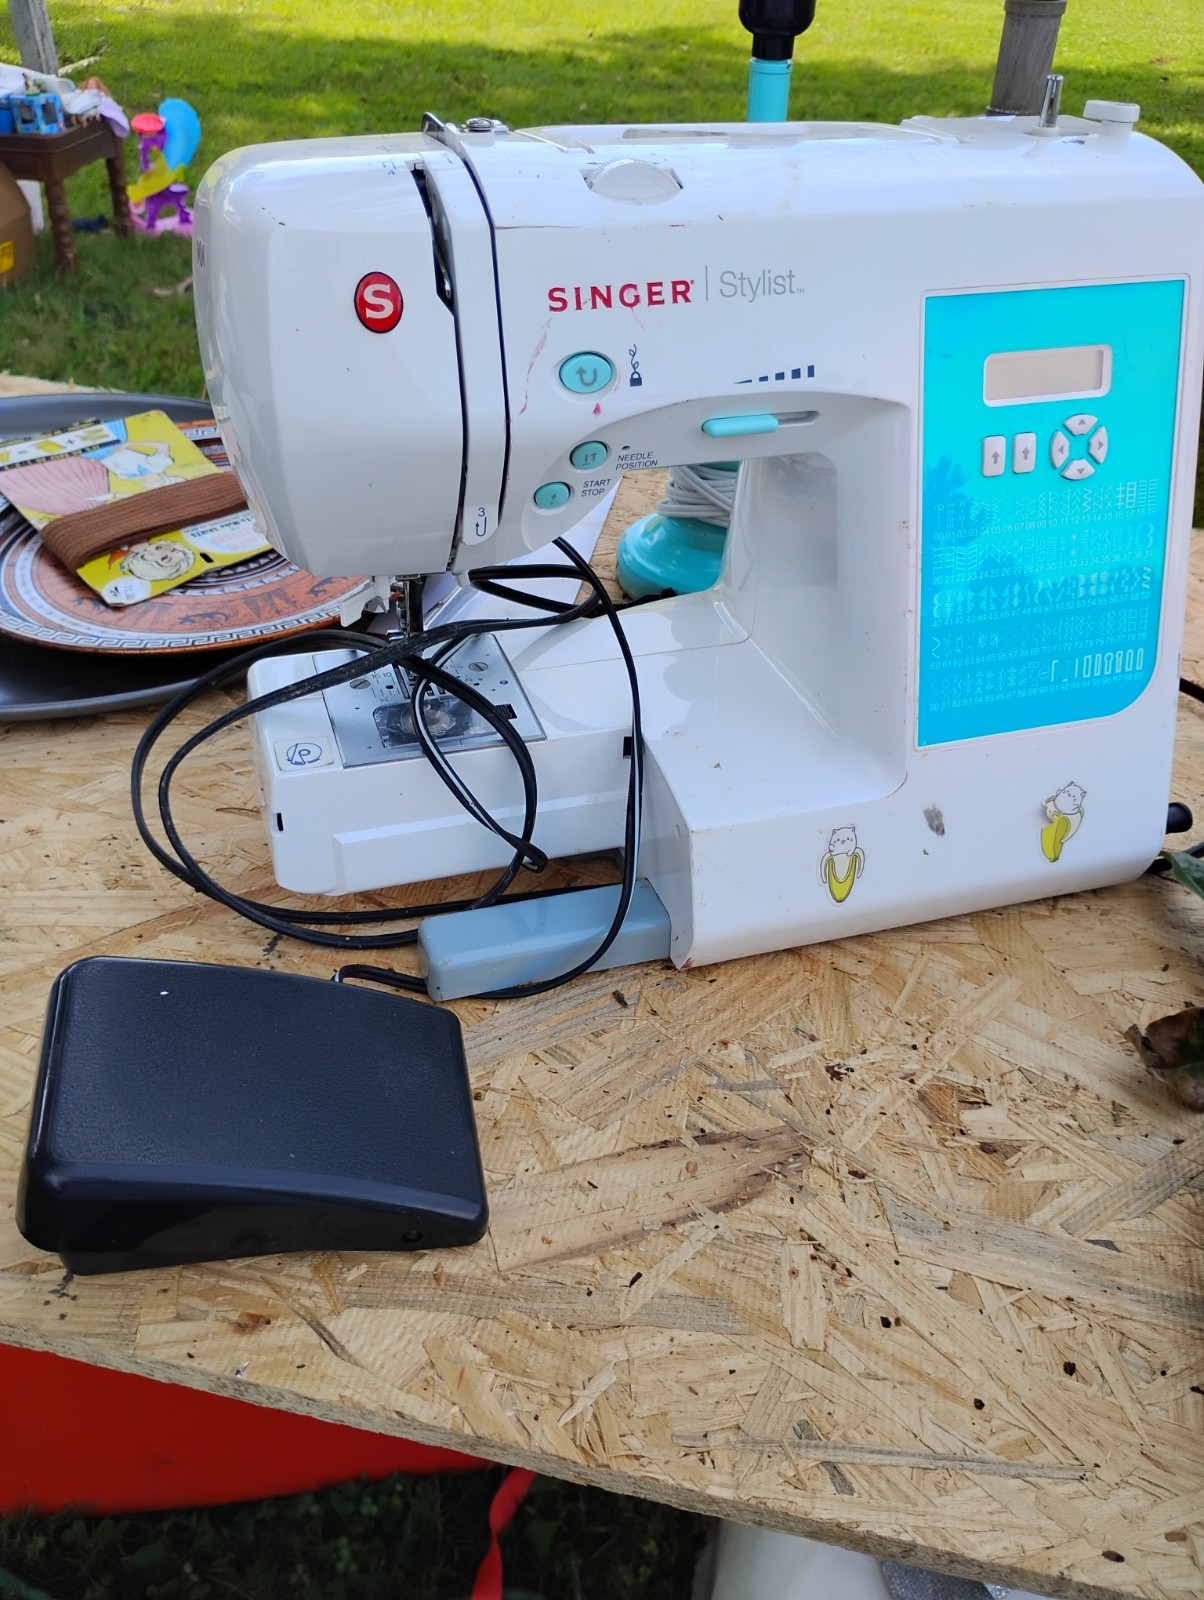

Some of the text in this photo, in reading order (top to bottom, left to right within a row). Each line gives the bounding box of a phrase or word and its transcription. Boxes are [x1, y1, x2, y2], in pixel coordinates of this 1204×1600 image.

[364, 284, 394, 319] S
[618, 452, 654, 462] NEEDLE
[616, 460, 658, 470] POSITION
[583, 479, 611, 488] START
[581, 488, 604, 497] STOP
[478, 507, 486, 517] 3
